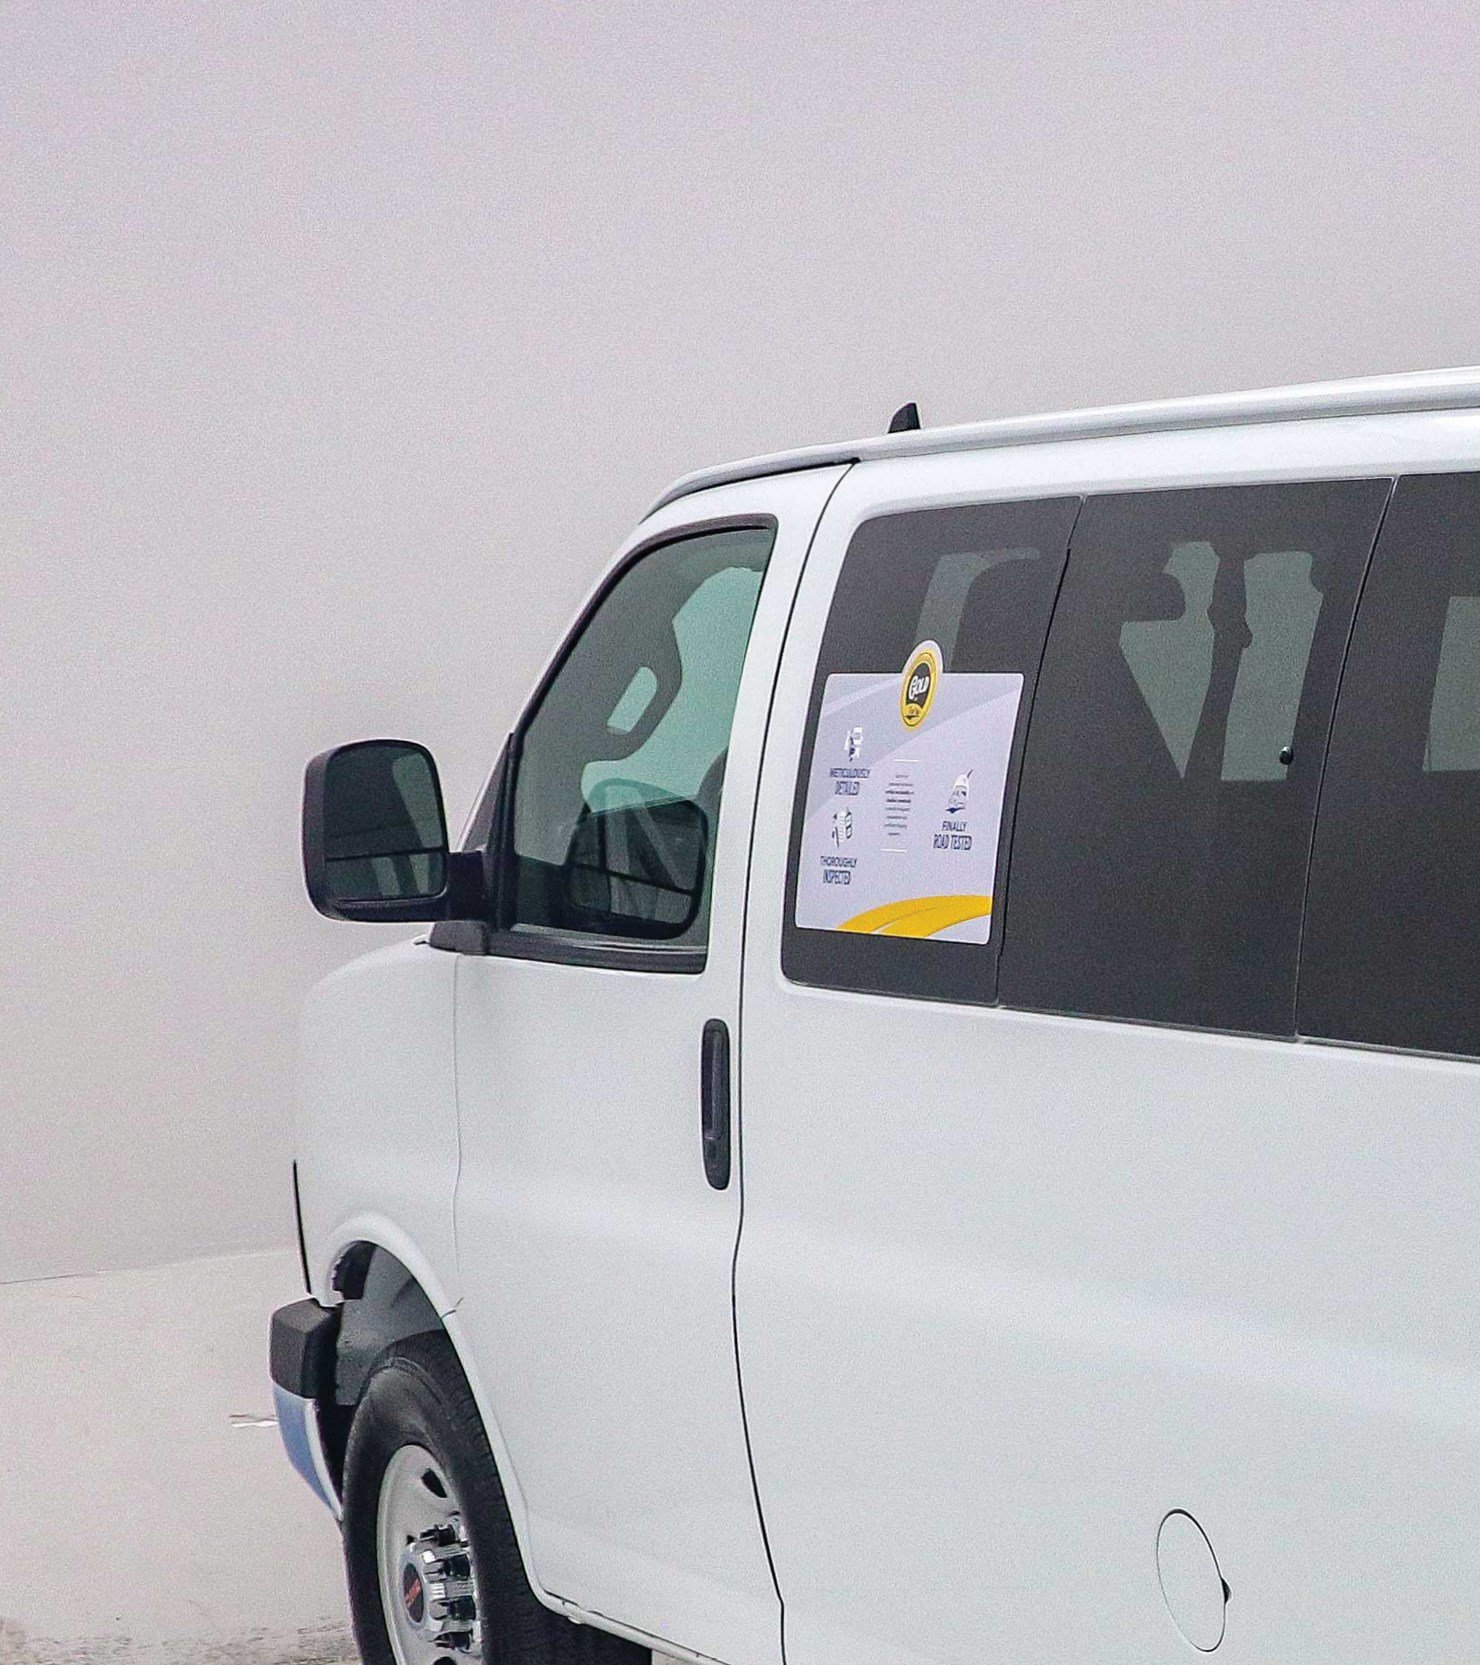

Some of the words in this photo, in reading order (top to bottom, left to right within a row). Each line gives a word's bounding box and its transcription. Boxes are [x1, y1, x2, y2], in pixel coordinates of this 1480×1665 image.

[908, 674, 930, 700] GOLD
[942, 821, 967, 832] FINALLY
[933, 834, 949, 850] ROAD
[950, 834, 973, 850] TESTED
